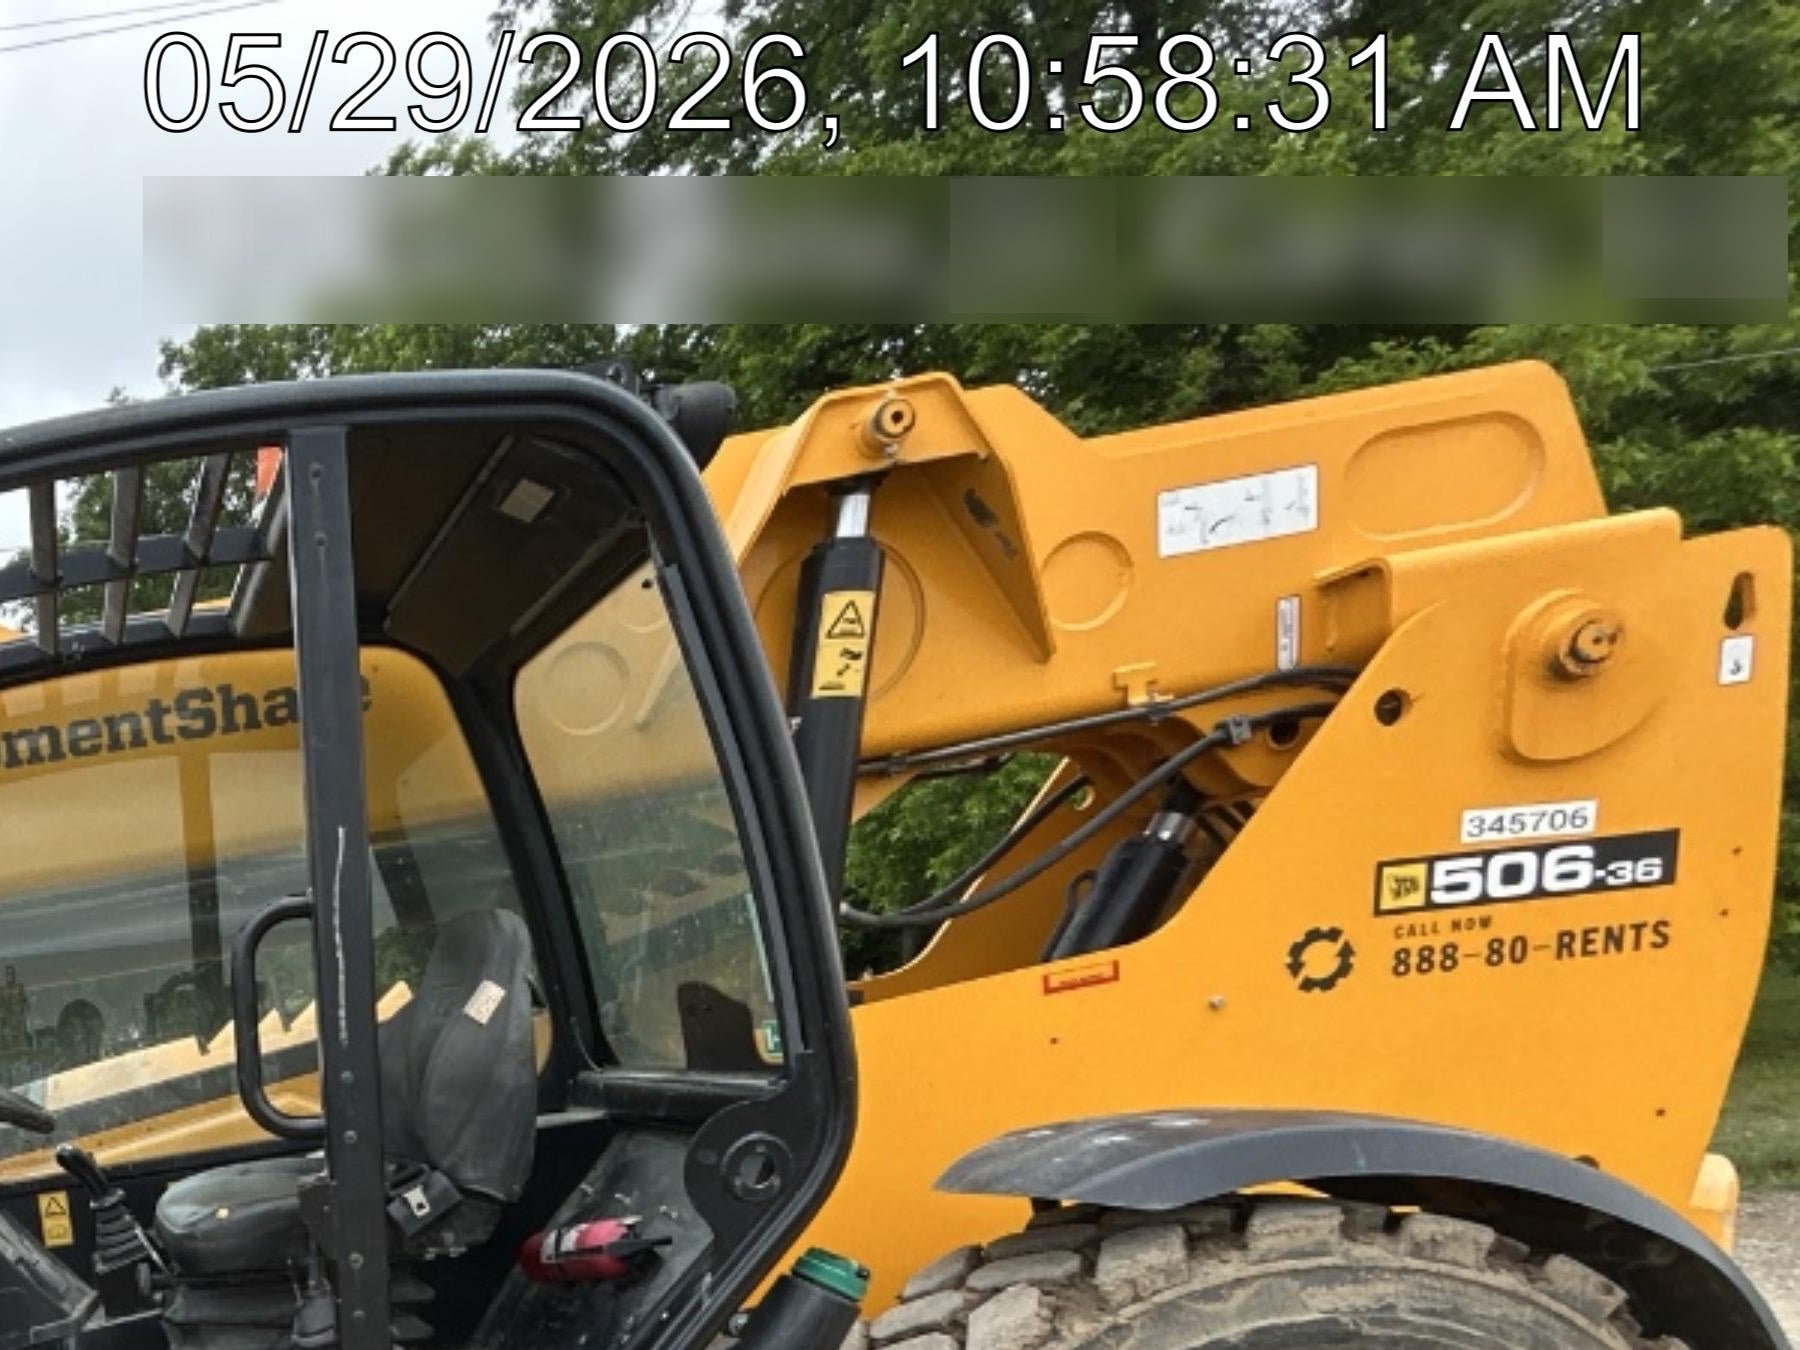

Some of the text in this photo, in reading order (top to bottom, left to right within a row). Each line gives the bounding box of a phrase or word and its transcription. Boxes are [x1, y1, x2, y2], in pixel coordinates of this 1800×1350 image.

[1465, 806, 1589, 839] 345706
[1431, 845, 1664, 905] 506-36
[1391, 920, 1671, 978] 888-80-RENTS
[1394, 915, 1493, 939] CALL NOW
